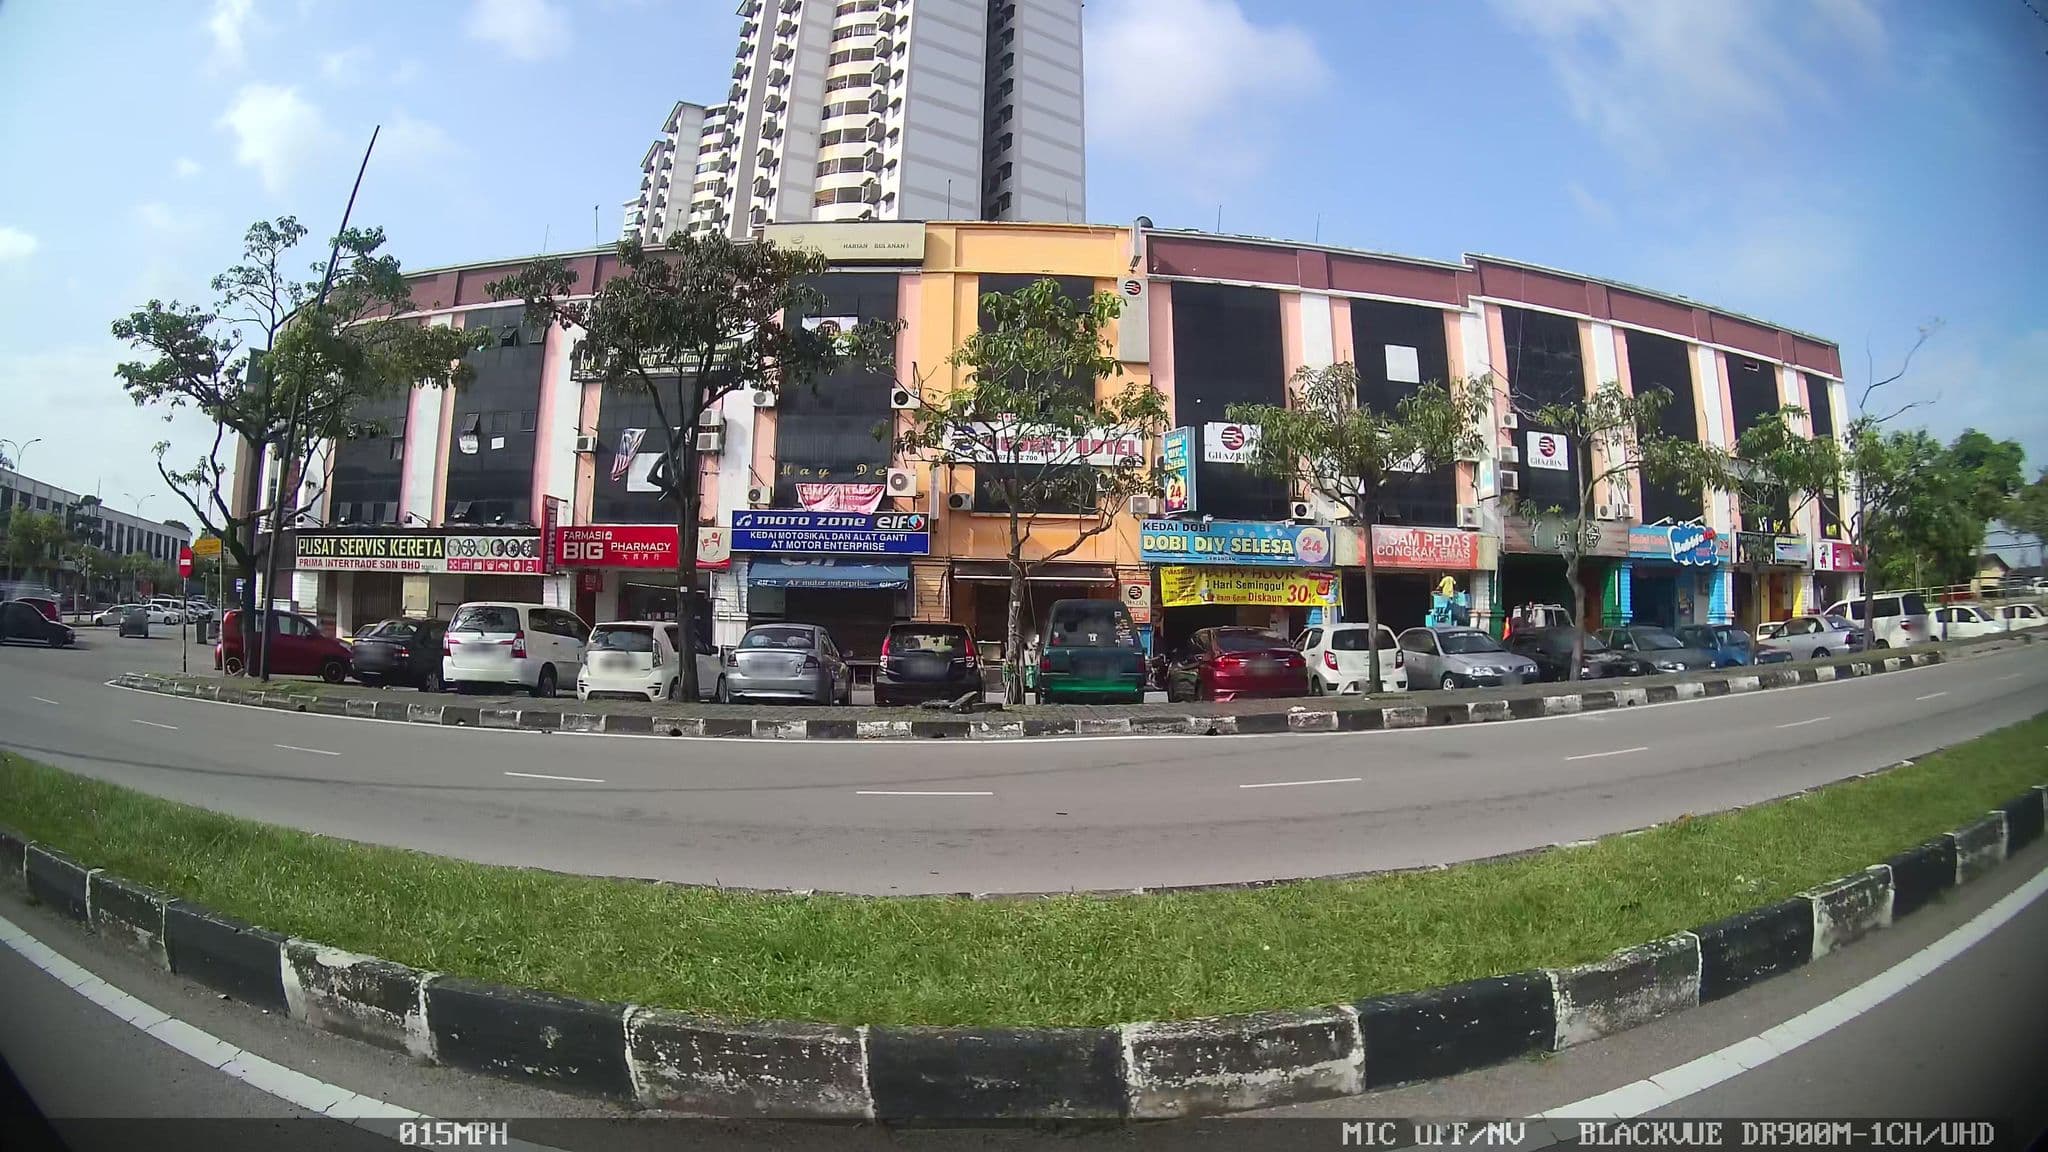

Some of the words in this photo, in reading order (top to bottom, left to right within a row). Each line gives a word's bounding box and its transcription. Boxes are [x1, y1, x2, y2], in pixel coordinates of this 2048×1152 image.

[876, 514, 907, 529] elf
[1142, 522, 1178, 532] KEDAI
[1182, 523, 1210, 532] DOBI
[563, 530, 604, 540] FARMASI
[750, 532, 777, 540] KEDAI
[778, 532, 830, 541] MOTOSIKAL
[832, 533, 851, 541] DAN
[853, 533, 877, 542] ALAT
[880, 534, 907, 542] GANTI
[1424, 533, 1471, 549] PEDAS
[298, 538, 337, 556] PUSAT
[340, 538, 386, 556] SERVIS
[390, 538, 443, 557] KERETA
[611, 542, 671, 551] PHARMACY
[771, 541, 784, 549] AT
[786, 541, 821, 550] MOTOR
[824, 542, 885, 551] ENTERPRISE
[1143, 535, 1188, 552] DOBI
[1194, 536, 1226, 553] DIY
[1231, 538, 1294, 555] SELESA
[1302, 536, 1322, 553] 24
[563, 542, 604, 560] BIG
[1376, 545, 1436, 558] CONGKAK
[1439, 547, 1471, 560] EMAS
[298, 558, 323, 567] PRIMA
[325, 559, 377, 568] INTERTRADE
[380, 560, 398, 569] SDN
[401, 560, 421, 570] BHD
[1252, 568, 1296, 580] HOUR
[1213, 580, 1232, 589] Hari
[1235, 581, 1285, 592] Seminggu!
[1248, 592, 1282, 602] Diskaun
